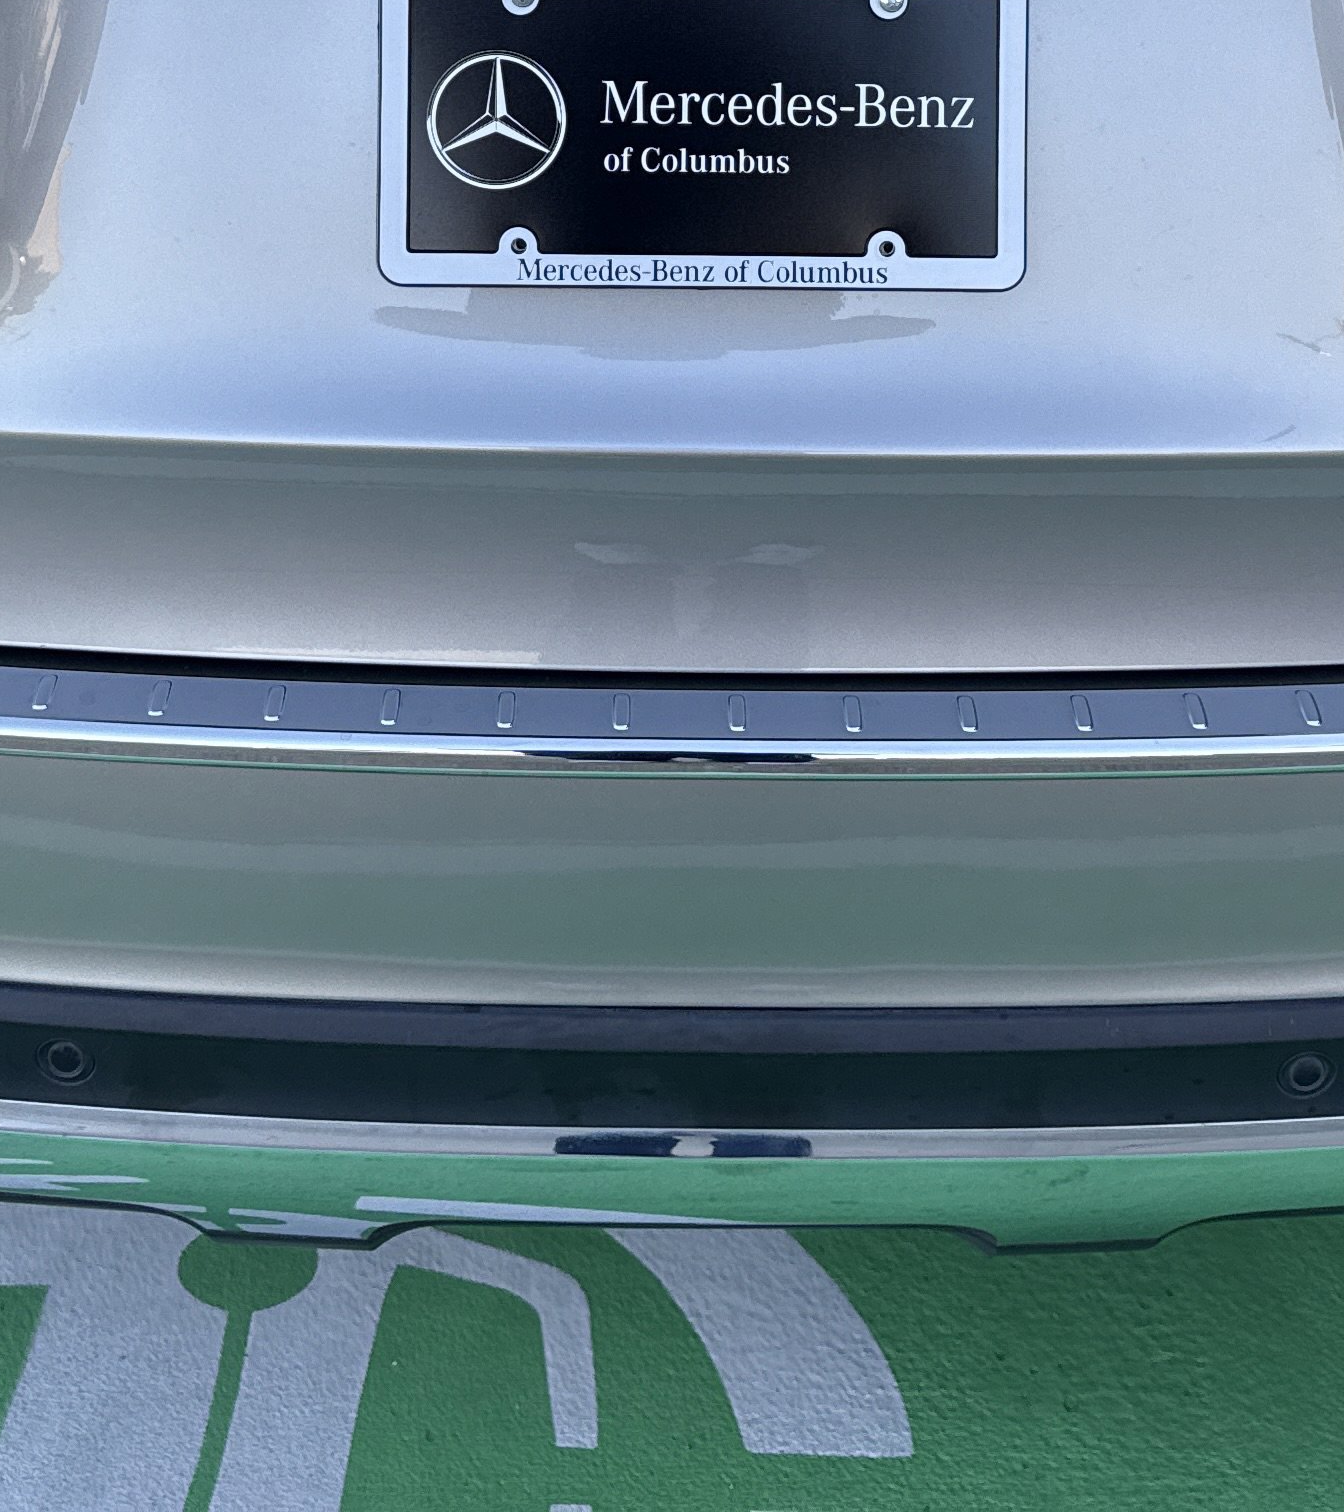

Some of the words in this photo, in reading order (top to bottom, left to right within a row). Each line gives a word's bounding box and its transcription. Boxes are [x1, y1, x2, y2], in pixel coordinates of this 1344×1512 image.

[599, 79, 975, 129] Mercedes-Benz
[603, 147, 633, 173] of
[640, 148, 790, 175] Columbus
[515, 258, 715, 283] Mercedes-Benz
[723, 259, 750, 284] of
[757, 260, 889, 285] Columbus
